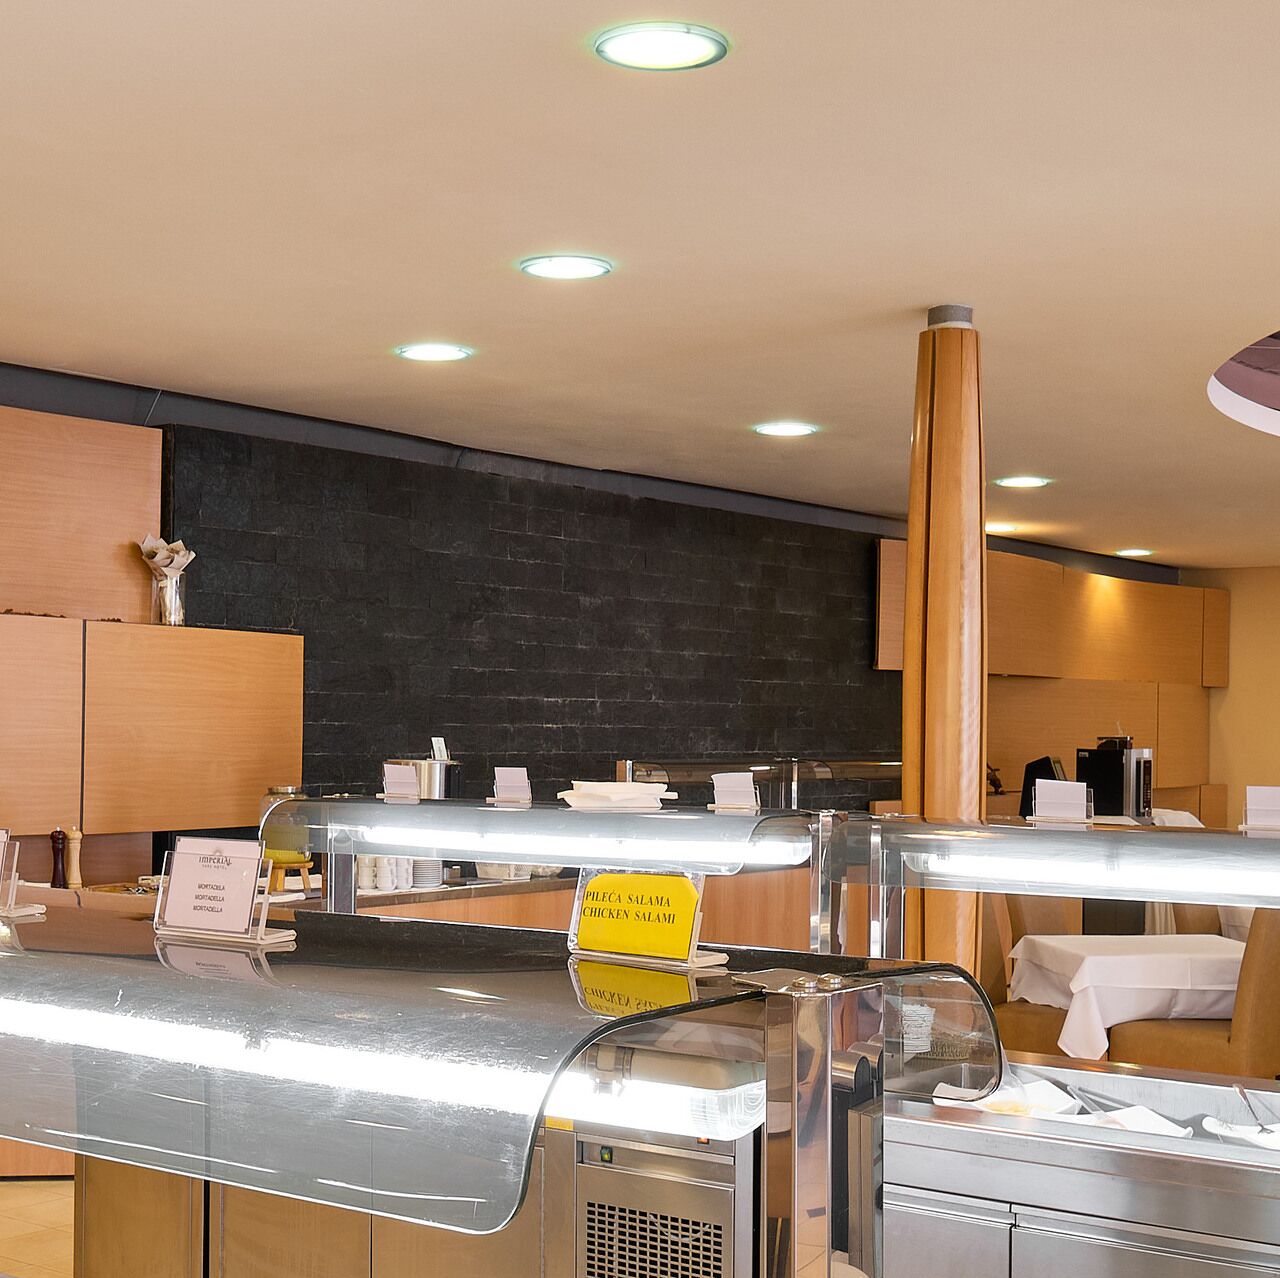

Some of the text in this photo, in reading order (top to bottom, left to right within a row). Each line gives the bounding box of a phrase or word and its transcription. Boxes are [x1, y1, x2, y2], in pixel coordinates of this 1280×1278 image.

[199, 855, 233, 867] IMPERIAL
[627, 893, 670, 907] SALAMA
[582, 906, 676, 925] CHICKEN SALAMI
